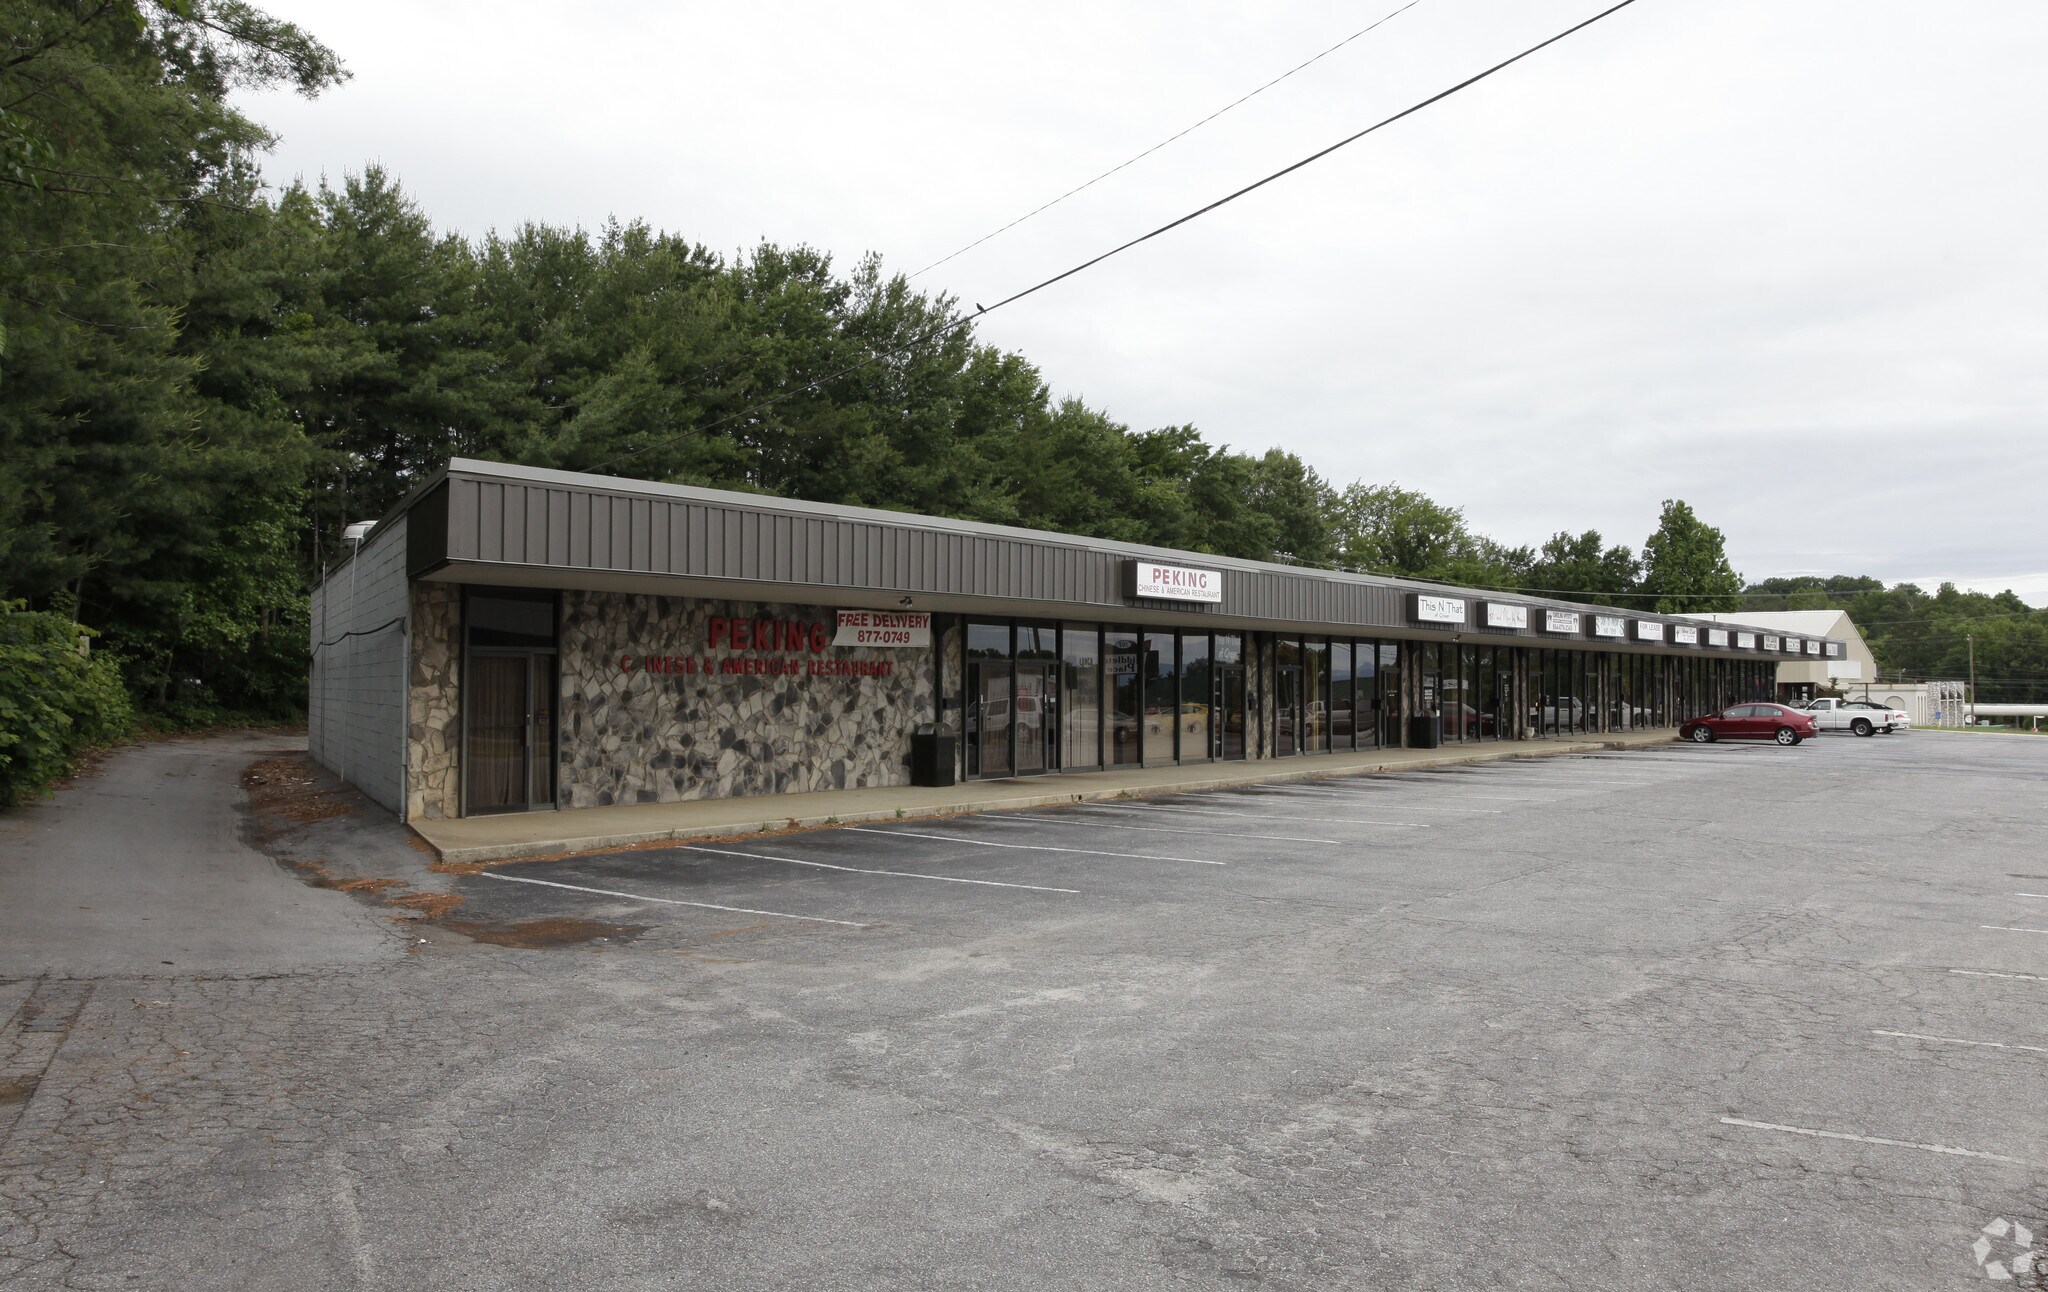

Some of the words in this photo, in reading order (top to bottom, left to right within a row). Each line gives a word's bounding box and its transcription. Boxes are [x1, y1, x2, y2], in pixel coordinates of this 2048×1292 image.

[1153, 568, 1207, 589] PEKING
[1138, 584, 1160, 593] CHINESE
[1166, 587, 1191, 596] AMERICAN
[1191, 590, 1220, 599] RESTAURANT
[1420, 599, 1437, 612] This
[1438, 599, 1445, 612] N
[1446, 602, 1463, 614] That
[837, 613, 869, 627] FREE
[872, 614, 929, 629] DELIVERY
[1648, 623, 1661, 632] LEASE
[708, 616, 827, 652] PEKING
[857, 630, 910, 644] 877-0749
[703, 658, 715, 675] &
[721, 657, 801, 676] AMERICAN
[808, 659, 893, 678] RESTAURANT
